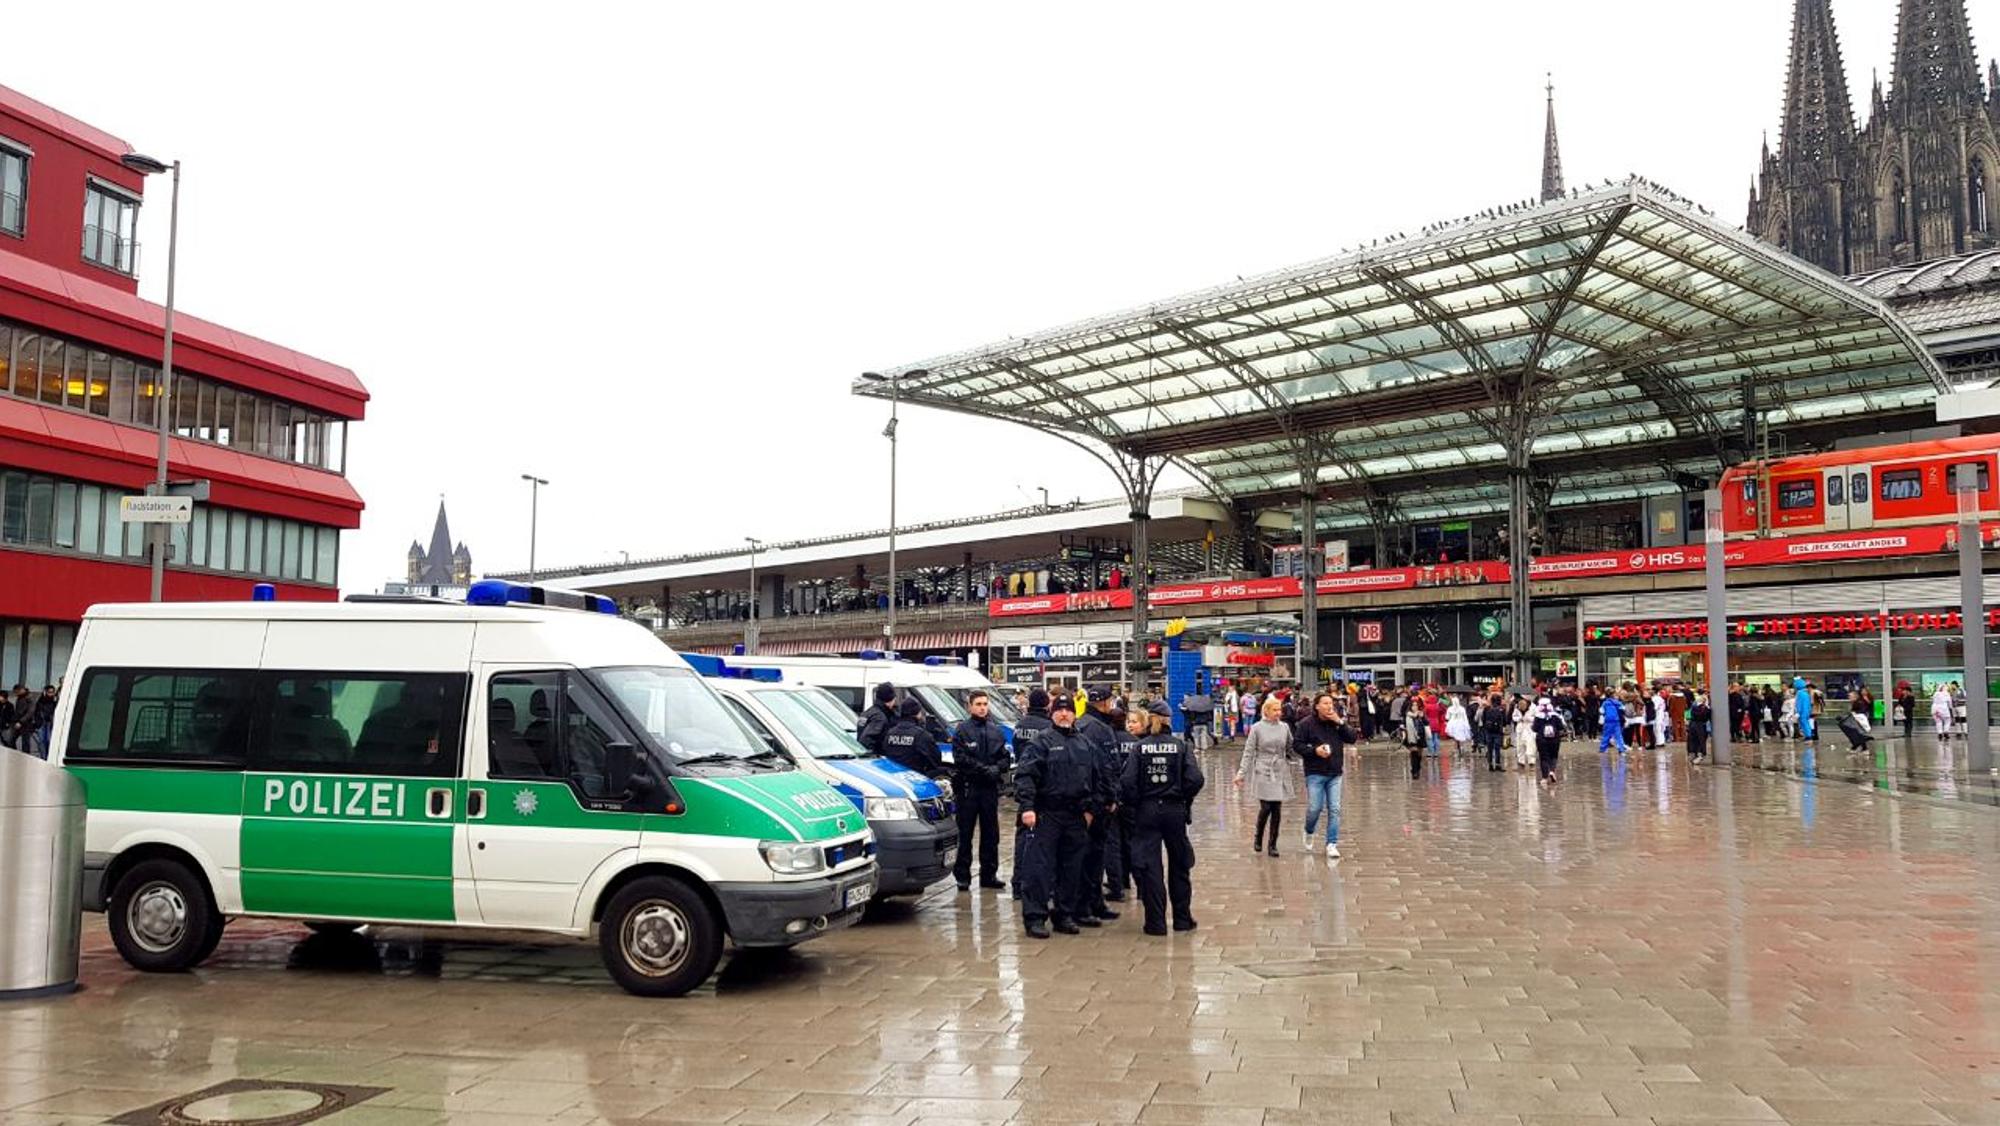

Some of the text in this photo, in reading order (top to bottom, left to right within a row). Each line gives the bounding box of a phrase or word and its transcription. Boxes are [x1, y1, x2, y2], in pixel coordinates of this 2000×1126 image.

[1648, 552, 1684, 566] HRS
[1481, 618, 1498, 637] S
[1609, 621, 1709, 640] APOTHEK
[1763, 611, 1963, 635] INTERNATIONA
[1360, 625, 1380, 640] DB
[1019, 641, 1099, 659] Mconald's
[888, 735, 914, 746] POLIZEI
[1141, 743, 1178, 754] POLIZEI
[264, 779, 406, 818] POLIZEI
